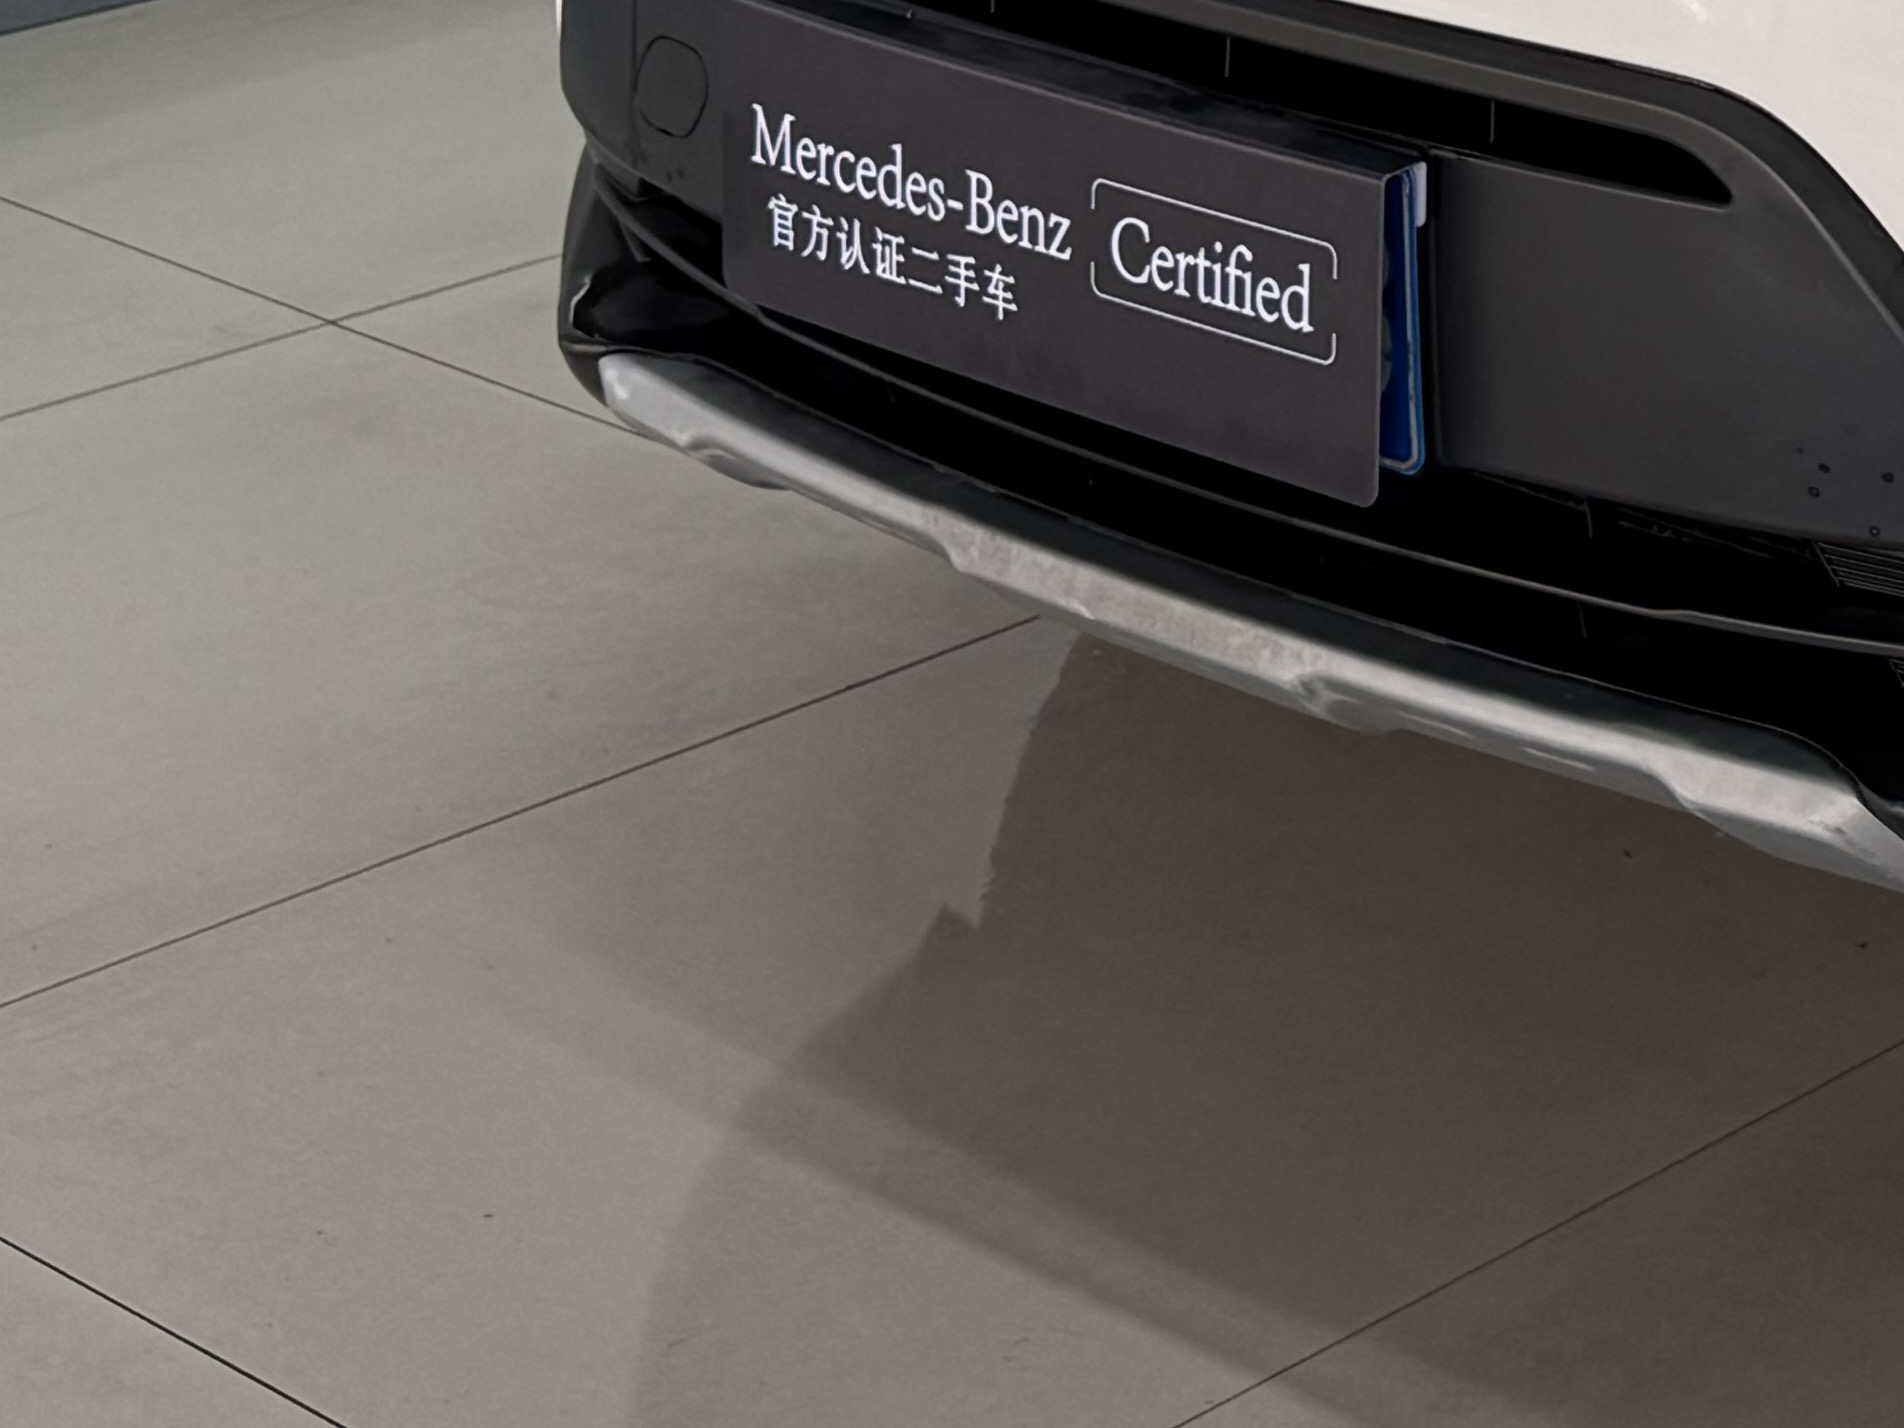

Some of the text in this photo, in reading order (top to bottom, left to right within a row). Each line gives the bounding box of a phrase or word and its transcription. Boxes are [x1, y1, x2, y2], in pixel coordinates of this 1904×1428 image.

[751, 102, 1315, 334] Mercedes-Benz Certified
[766, 193, 1020, 322] 官方认证二手车
